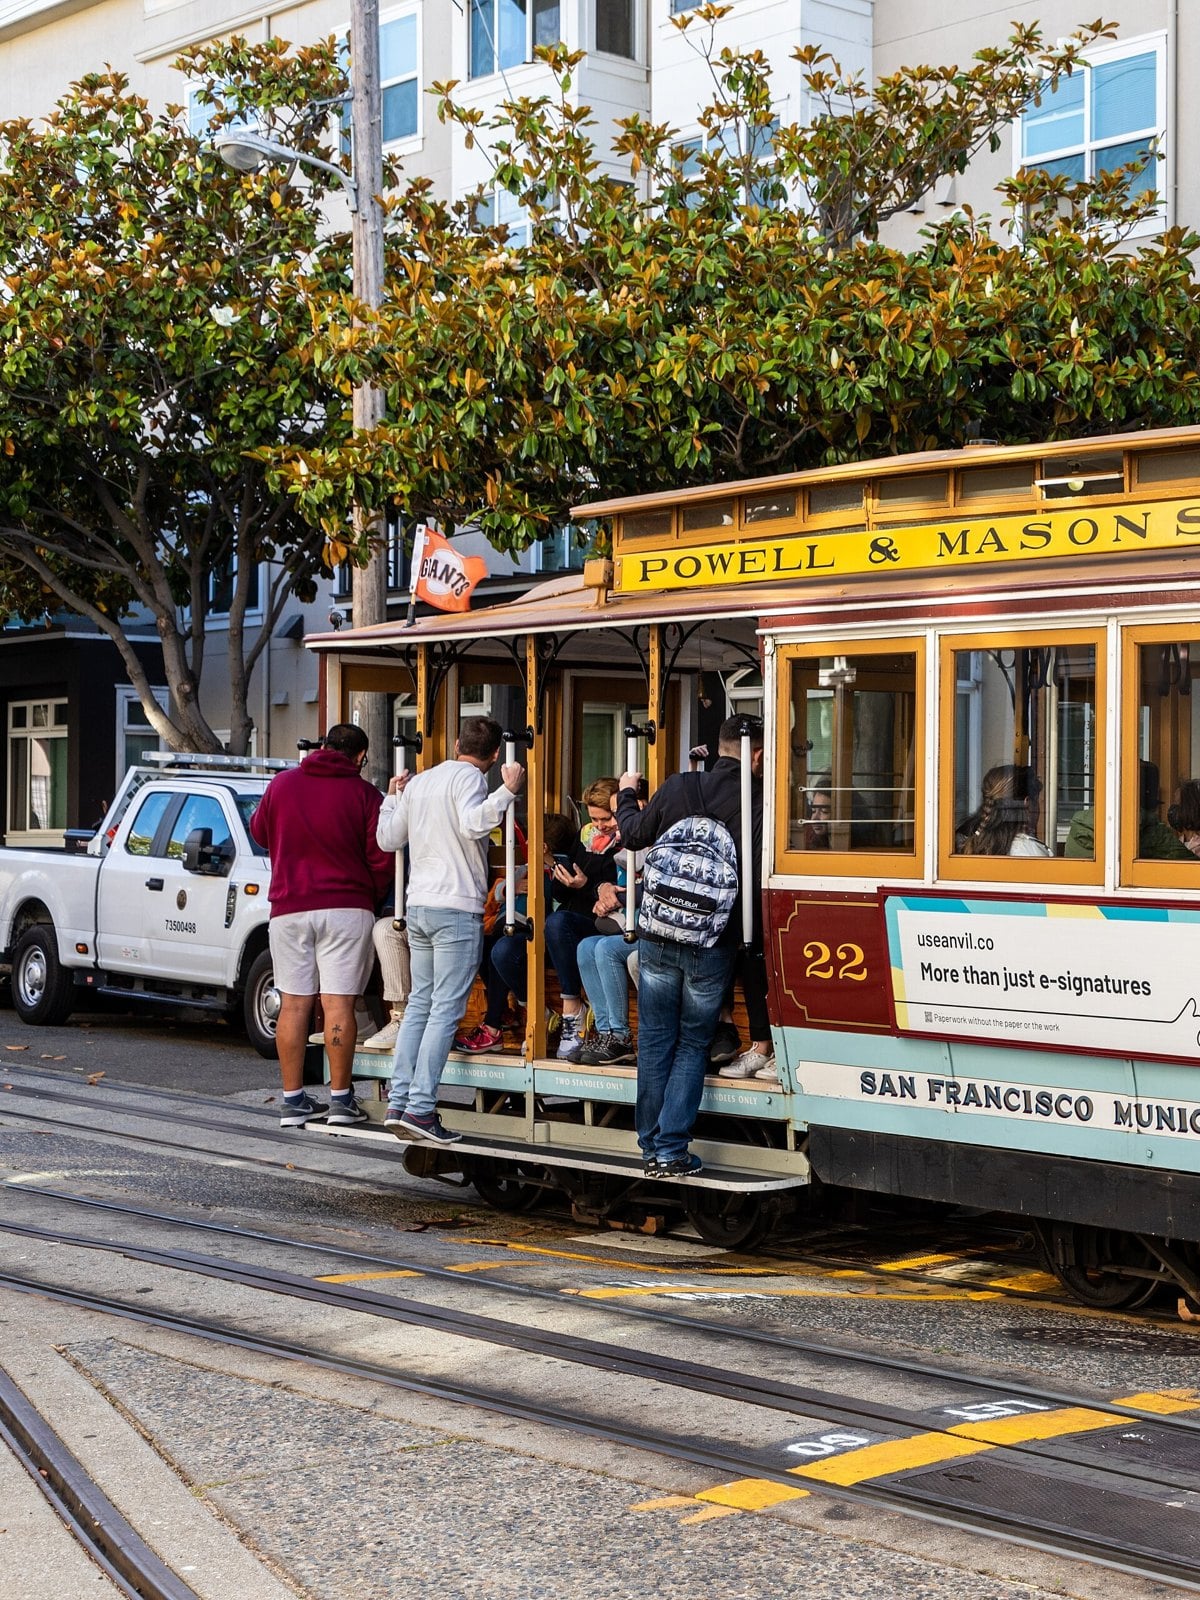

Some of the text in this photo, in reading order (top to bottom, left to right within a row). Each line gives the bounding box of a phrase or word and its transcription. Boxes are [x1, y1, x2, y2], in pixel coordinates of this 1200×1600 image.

[639, 544, 835, 582] POWELL
[868, 536, 901, 564] &
[936, 511, 1152, 557] MASON
[165, 919, 196, 934] 73500498
[917, 931, 994, 951] useanvil.co
[803, 941, 867, 981] 22
[920, 962, 1151, 996] More than just e-signatures
[934, 1013, 967, 1024] Paperwork
[968, 1016, 991, 1027] without
[993, 1018, 1003, 1027] the
[1004, 1020, 1023, 1030] paper
[1032, 1021, 1042, 1030] the
[1044, 1022, 1060, 1032] work
[457, 1068, 488, 1078] STANDEES
[489, 1070, 506, 1080] ONLY
[555, 1077, 624, 1091] TWO STANDEES ONLY
[738, 1095, 759, 1106] ONLY
[860, 1071, 917, 1099] SAN
[927, 1078, 1094, 1122] FRANCISCO
